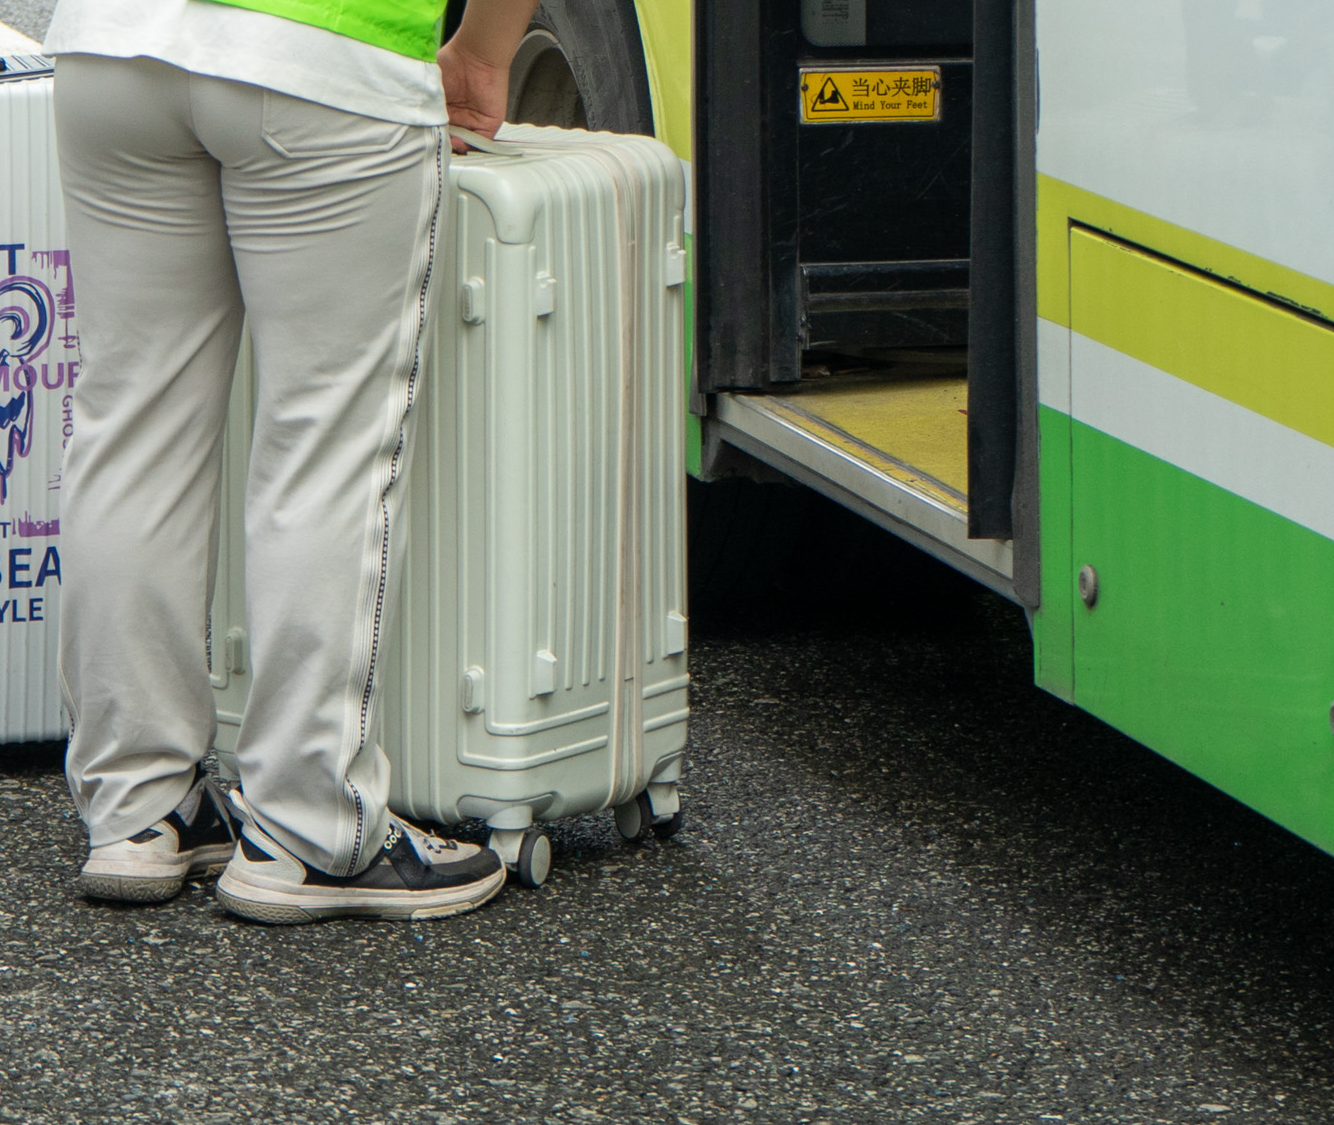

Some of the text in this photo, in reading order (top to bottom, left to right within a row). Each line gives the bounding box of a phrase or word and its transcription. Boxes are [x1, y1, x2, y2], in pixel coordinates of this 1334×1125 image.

[852, 76, 932, 98] 当心夹脚
[853, 100, 928, 111] Mind Your Feet
